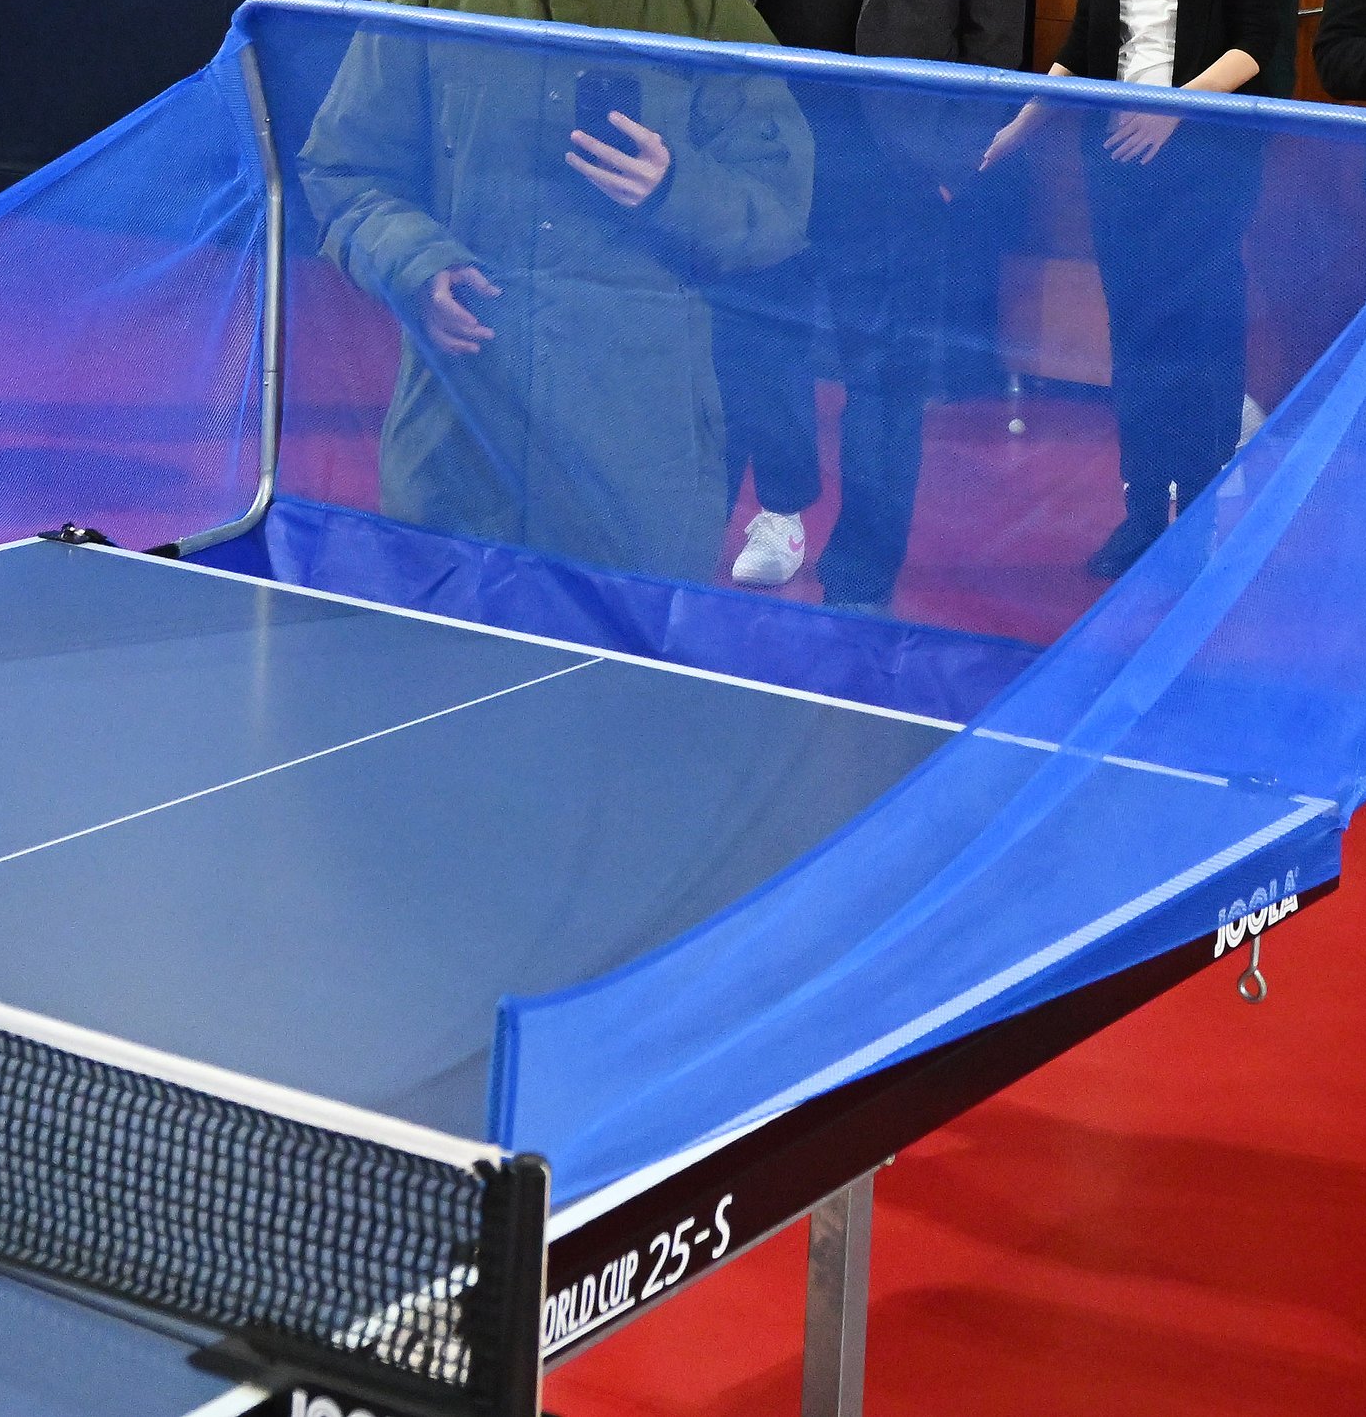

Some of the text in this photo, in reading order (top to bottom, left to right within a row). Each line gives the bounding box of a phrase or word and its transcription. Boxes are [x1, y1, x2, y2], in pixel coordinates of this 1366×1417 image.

[1214, 869, 1299, 959] JOOLA
[540, 1193, 733, 1348] ORLD CUP 25-S
